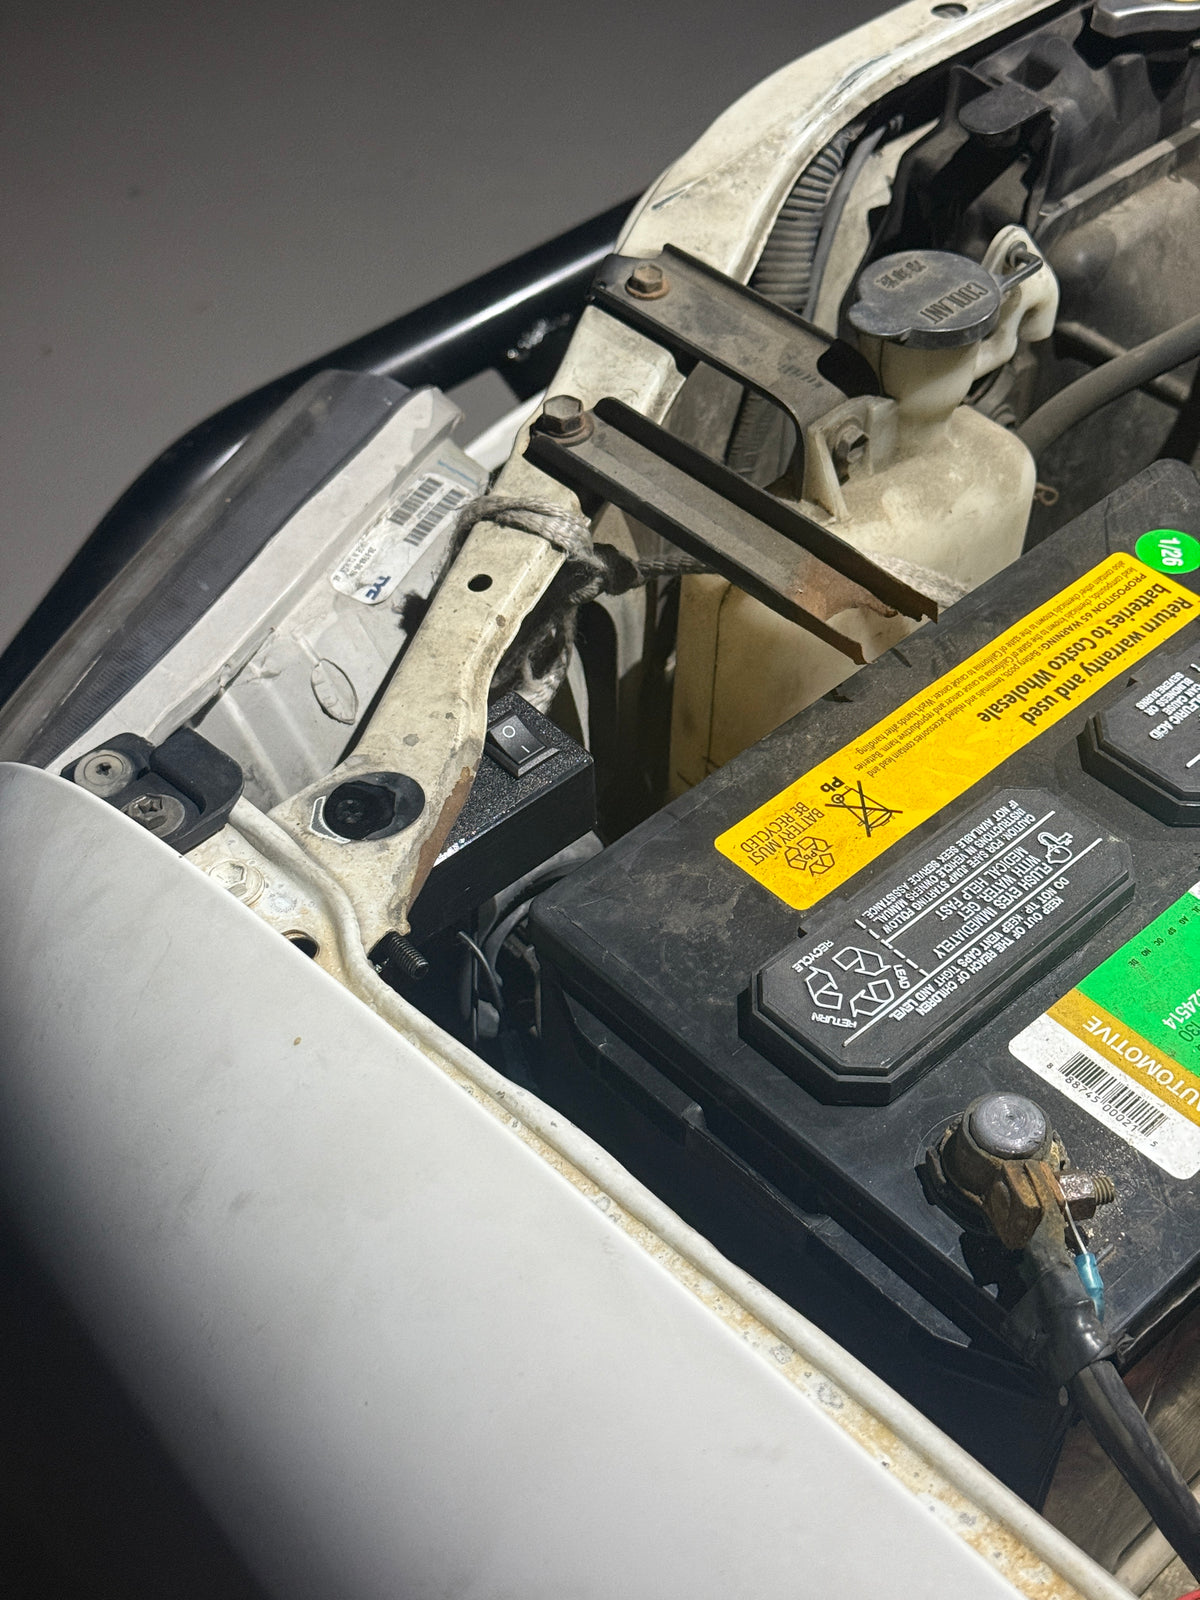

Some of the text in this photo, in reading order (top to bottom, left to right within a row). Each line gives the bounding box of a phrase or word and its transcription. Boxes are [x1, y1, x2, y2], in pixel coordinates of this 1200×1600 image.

[920, 282, 988, 324] COOLANT
[1158, 538, 1184, 566] 1/26
[365, 575, 391, 600] TYC
[975, 582, 1171, 726] batteries to Costco Wholesale
[1018, 595, 1194, 726] Return warranty and used
[865, 572, 1147, 778] PROPOSITION 65 WARNING: Battery posts, terminals and related accessories contain lead and
[1144, 677, 1194, 716] BLINDNESS OR
[1162, 696, 1188, 716] CAUSE
[1149, 720, 1174, 740] ACID
[818, 775, 844, 795] Pb
[738, 801, 810, 854] BE RECYCLED
[744, 807, 824, 866] BATTERY MUST
[801, 849, 817, 861] Pb
[860, 799, 1019, 920] IF NOT AVAILABLE SEEK SERVICE ASSISTANCE.
[872, 806, 1027, 926] INSTRUCTIONS IN VEHICLE OWNERS MANUAL.
[880, 812, 1036, 934] CAUTION: FOR SAFE JUMP STARTING FOLLOW
[932, 845, 1030, 920] MEDICAL HELP FAST
[955, 852, 1042, 921] WITH WATER. GET
[1052, 876, 1070, 890] DO
[929, 861, 1054, 959] FLUSH EYES IMMEDIATELY
[1035, 886, 1057, 903] NOT
[998, 913, 1024, 933] KEEP
[913, 895, 1064, 1015] KEEP OUT OF THE REACH OF CHILDREN
[977, 929, 1004, 950] VENT
[792, 940, 834, 972] RECYCLE
[955, 946, 983, 967] CAPS
[893, 964, 910, 990] LEAD
[932, 963, 961, 986] TIGHT
[913, 983, 937, 1001] AND
[811, 1012, 857, 1028] RETURN
[887, 997, 919, 1022] LEVEL
[1082, 1016, 1200, 1112] UTOMOTIVE
[1065, 1076, 1102, 1104] 88745
[1102, 1104, 1138, 1132] 00021
